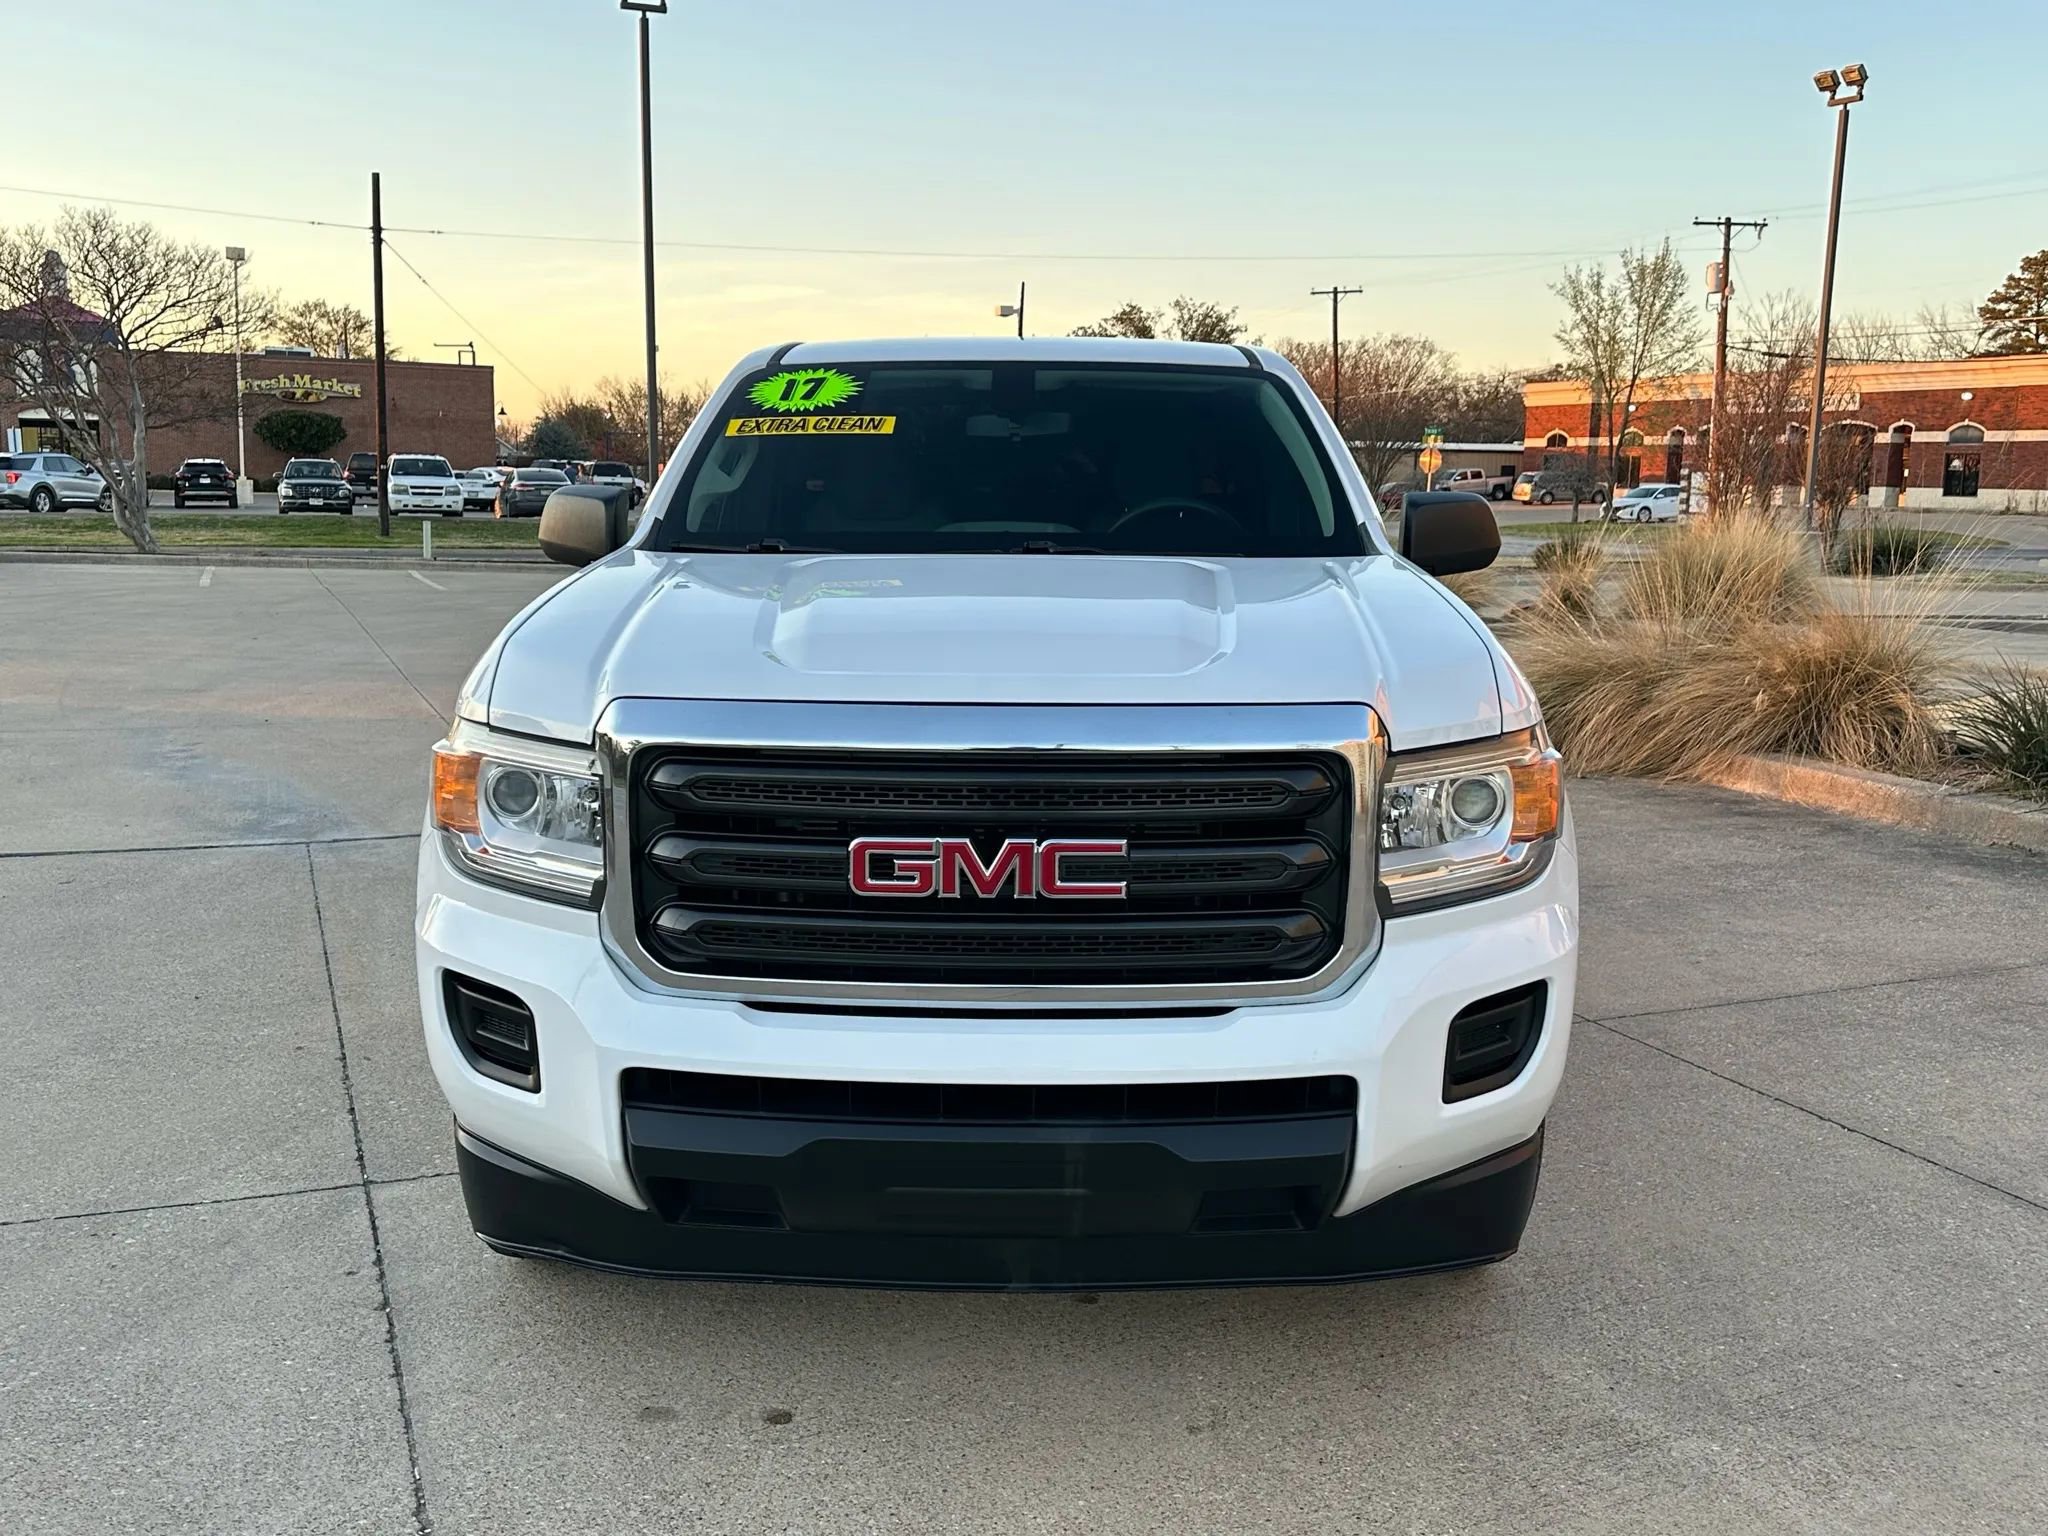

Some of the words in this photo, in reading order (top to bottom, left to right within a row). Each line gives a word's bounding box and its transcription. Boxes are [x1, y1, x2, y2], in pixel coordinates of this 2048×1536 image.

[293, 374, 362, 398] Market
[779, 376, 829, 402] 17
[736, 418, 809, 434] EXTRA
[812, 417, 886, 433] CLEAN
[848, 837, 1128, 899] GMC
